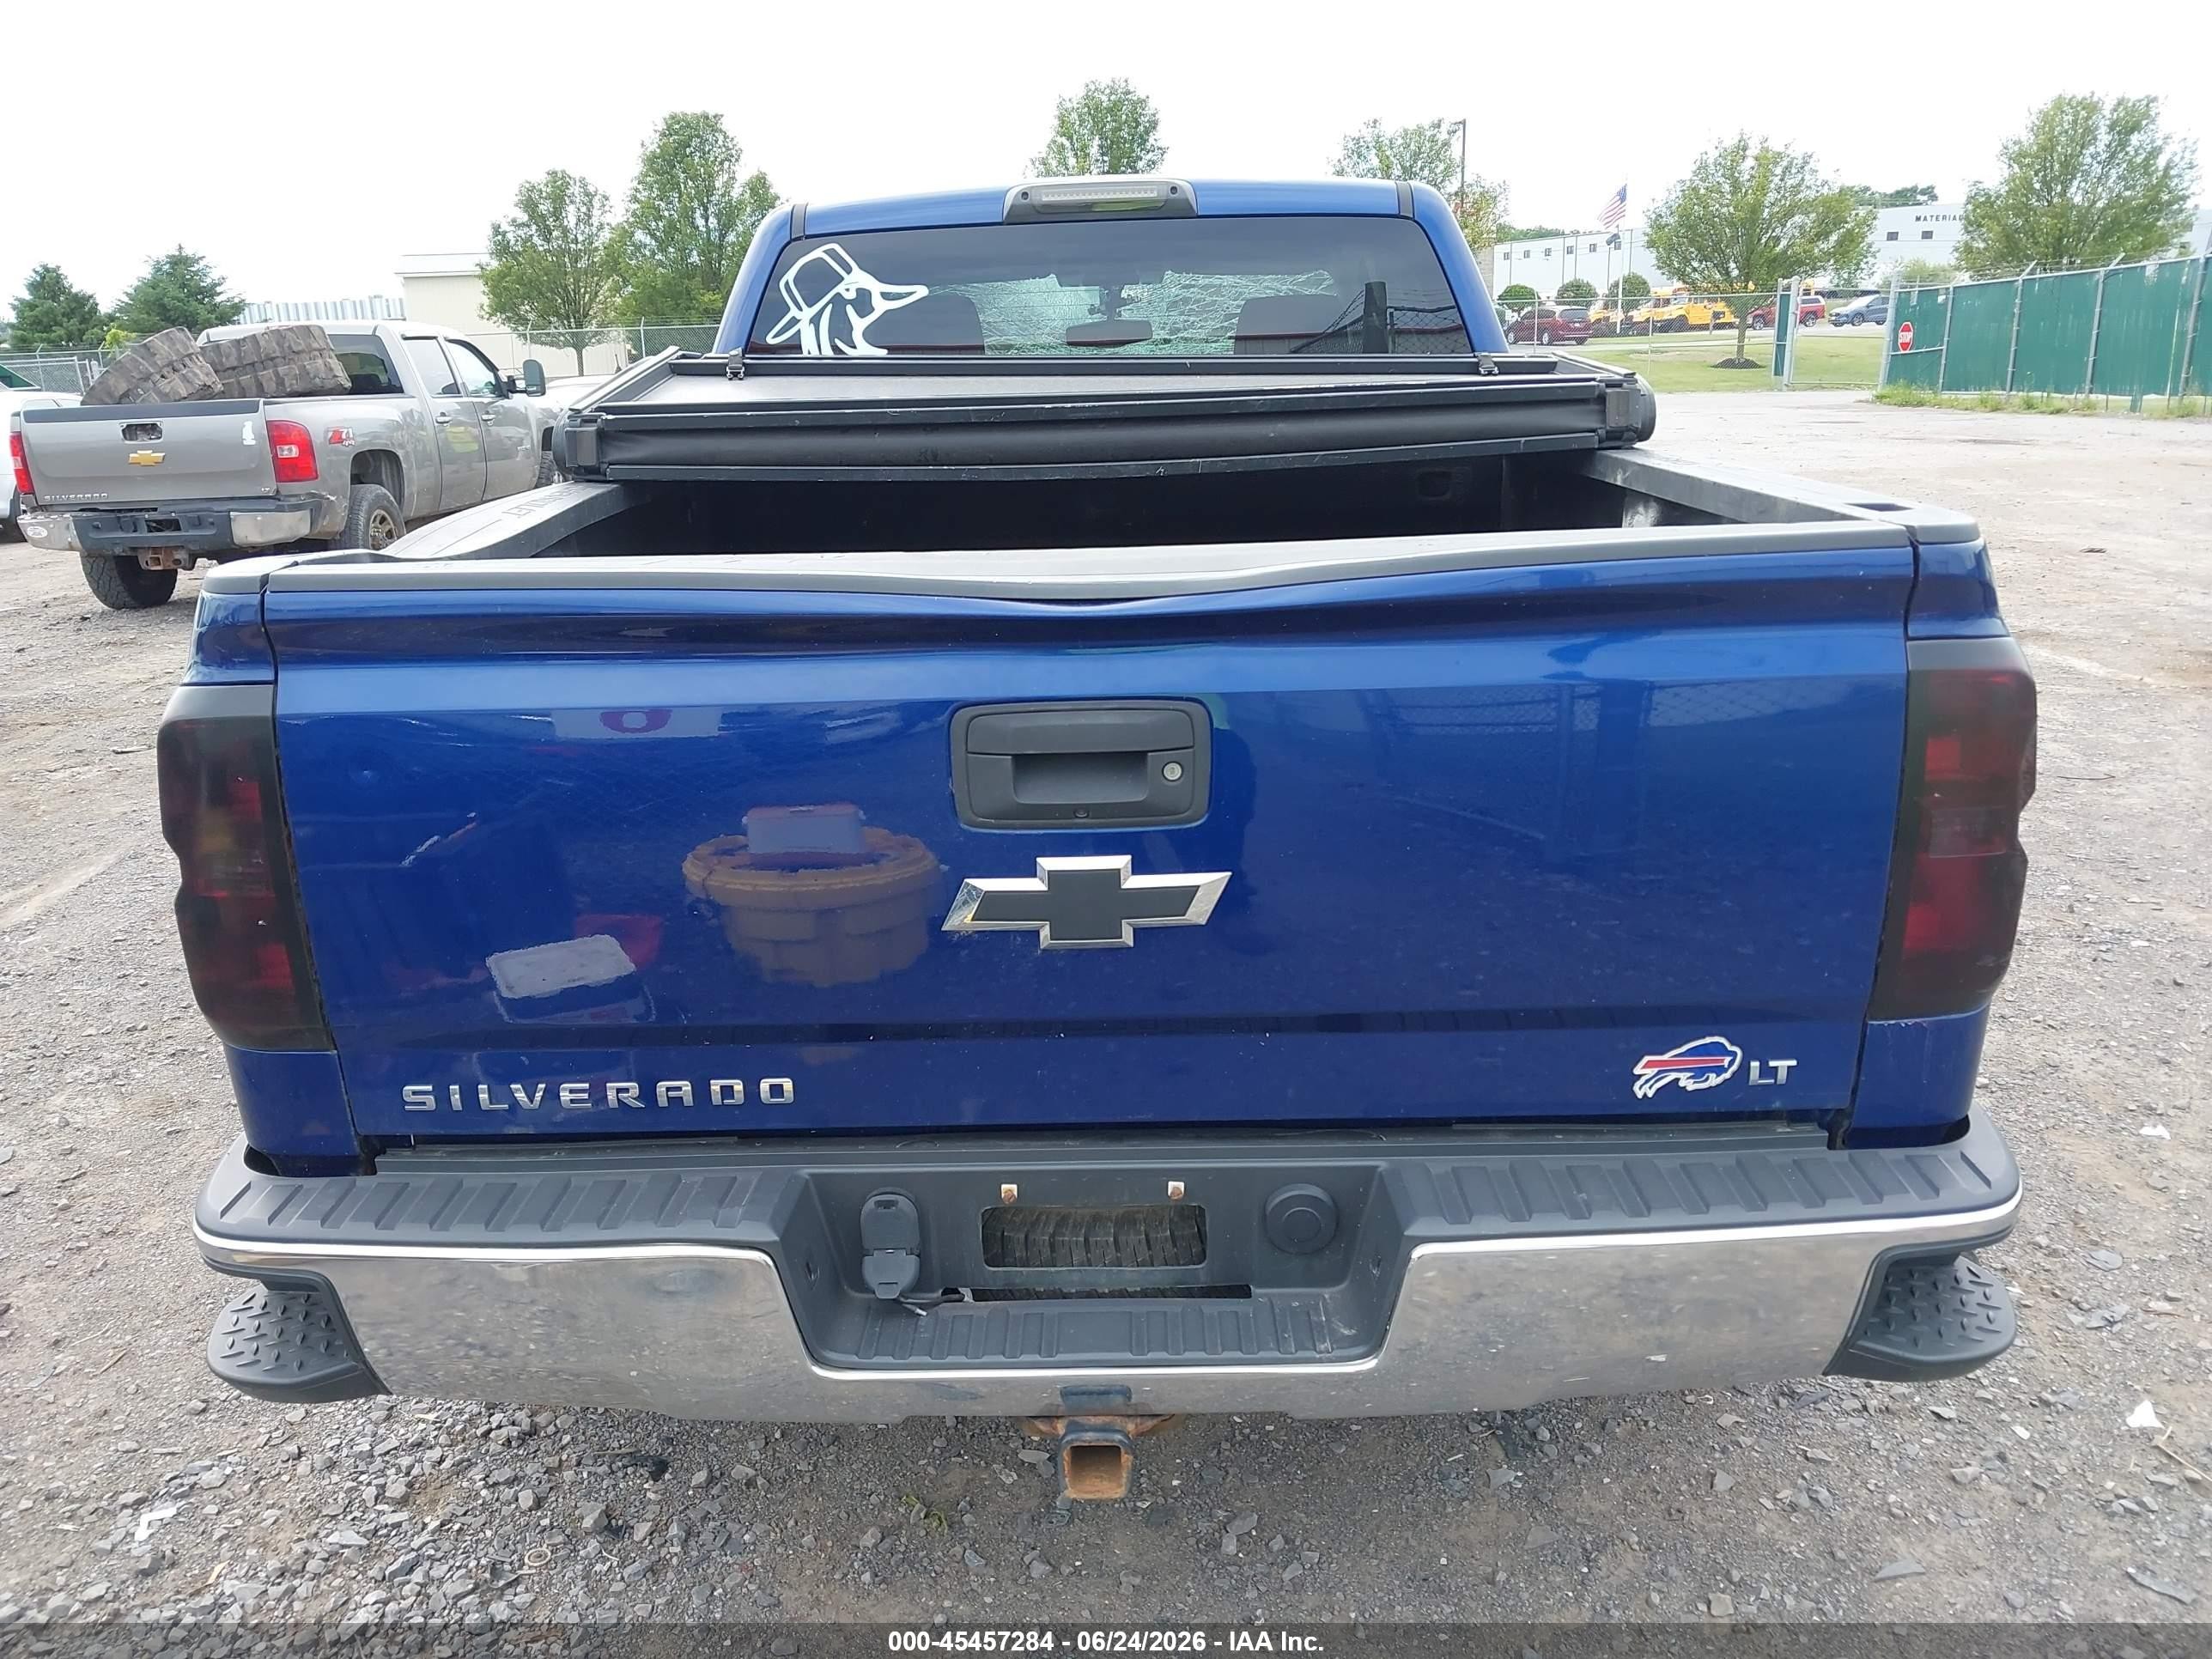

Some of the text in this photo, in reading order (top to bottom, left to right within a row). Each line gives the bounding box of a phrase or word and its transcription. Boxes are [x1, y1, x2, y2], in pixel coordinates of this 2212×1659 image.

[1899, 331, 1913, 343] STOP
[1748, 1059, 1798, 1086] LT
[402, 1077, 795, 1111] SILVERADO
